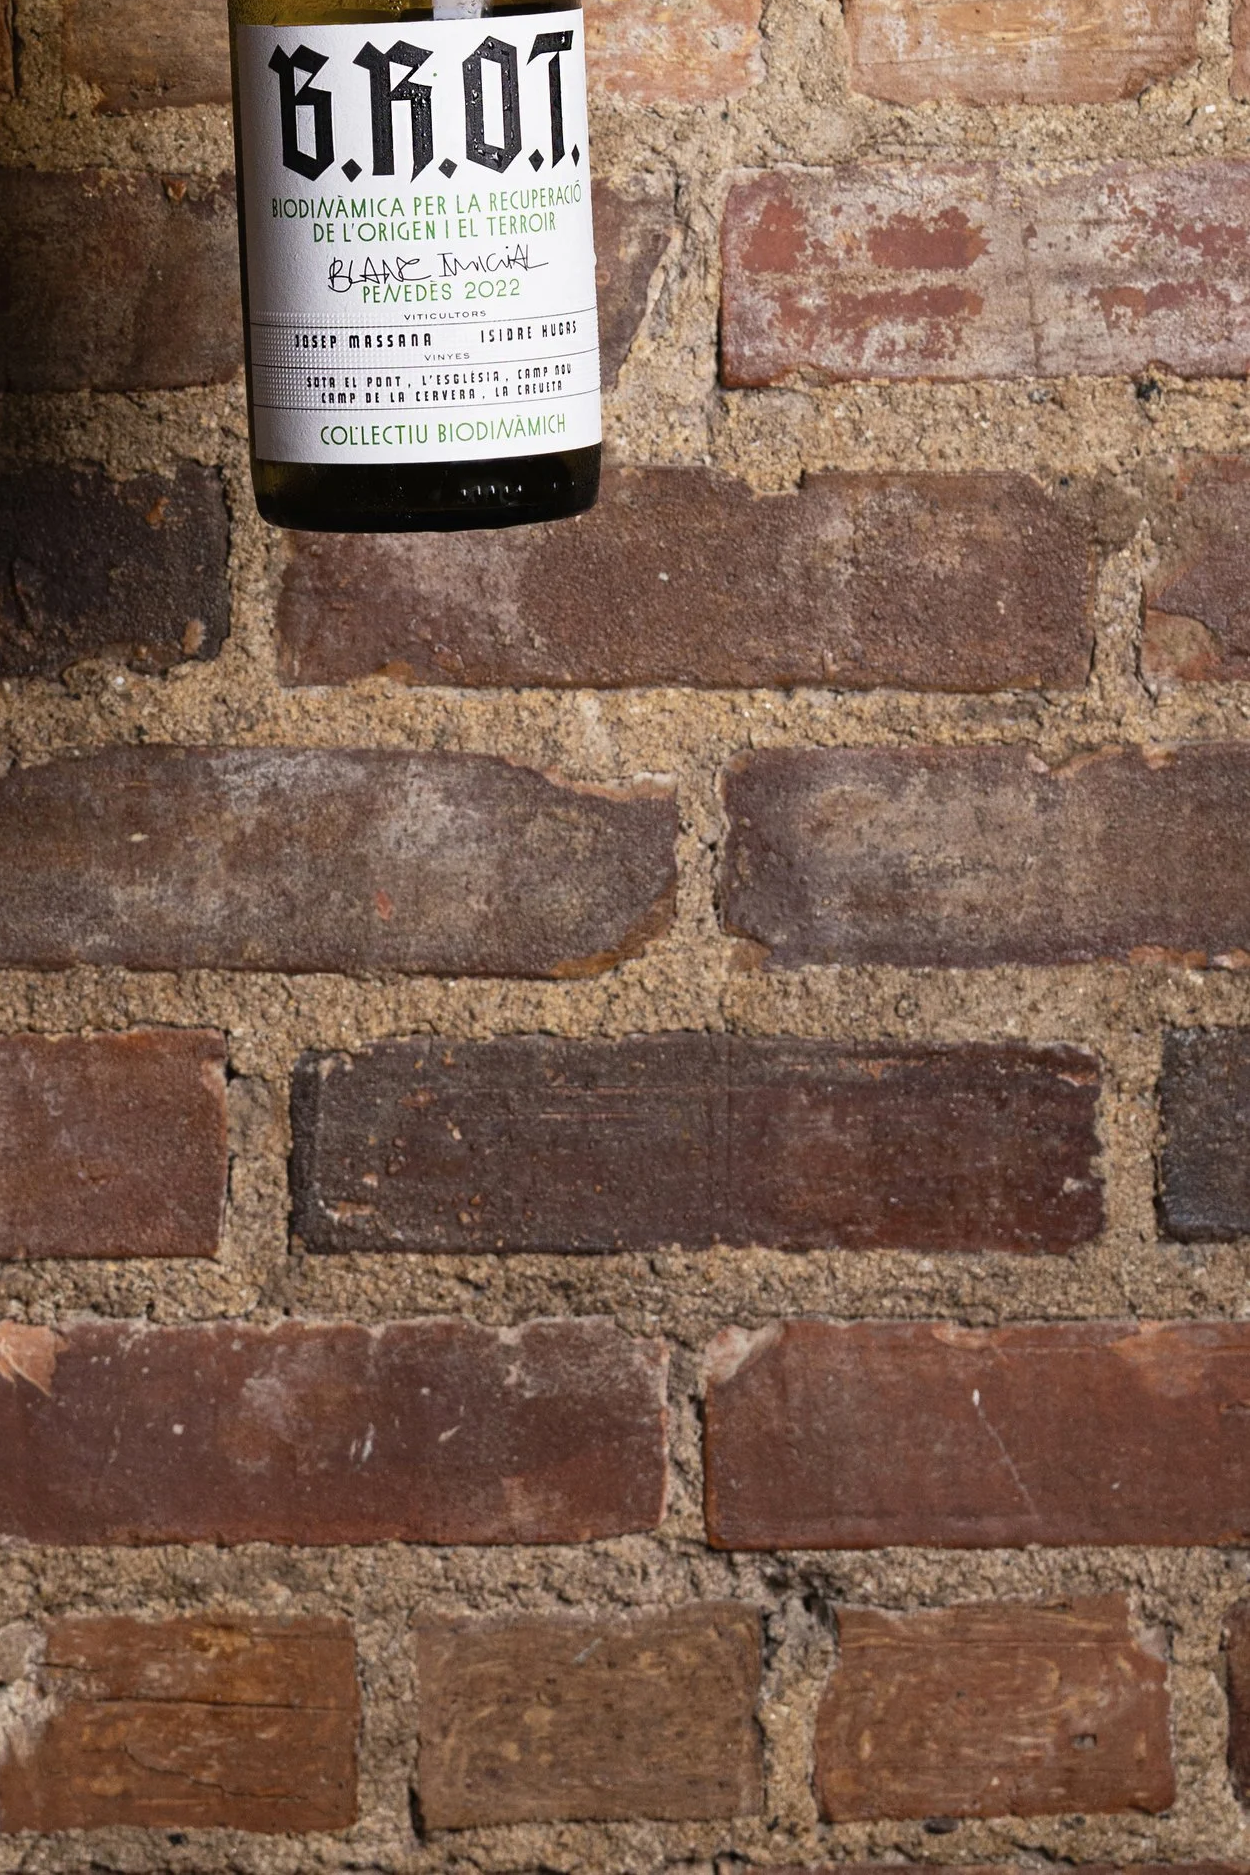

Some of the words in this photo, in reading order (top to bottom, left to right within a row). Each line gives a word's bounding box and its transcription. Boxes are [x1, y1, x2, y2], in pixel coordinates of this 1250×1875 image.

[272, 194, 406, 219] BIODINÀMICA
[414, 196, 447, 216] PER
[456, 193, 482, 214] LA
[489, 180, 583, 212] RECUPERACIÓ
[313, 223, 335, 243] DE
[343, 220, 436, 243] L'ORIGEN
[444, 220, 450, 239] I
[458, 218, 479, 238] EL
[486, 211, 556, 236] TERROIR
[362, 280, 452, 304] PENEDÈS
[464, 278, 521, 300] 2022
[403, 309, 487, 321] VITICULTORS
[295, 334, 337, 349] JOSEP
[348, 332, 432, 349] MASSANA
[480, 326, 532, 343] ISIDRE
[542, 320, 577, 338] HUGAS
[424, 352, 471, 362] VINYES
[306, 376, 336, 389] SOTA
[344, 376, 357, 388] EL
[517, 366, 548, 380] CAMP
[321, 392, 356, 404] CAMP
[365, 392, 380, 404] DE
[390, 391, 405, 403] LA
[495, 385, 508, 397] LA
[517, 380, 562, 396] CREUETA
[438, 413, 566, 443] BIODINÀMICH
